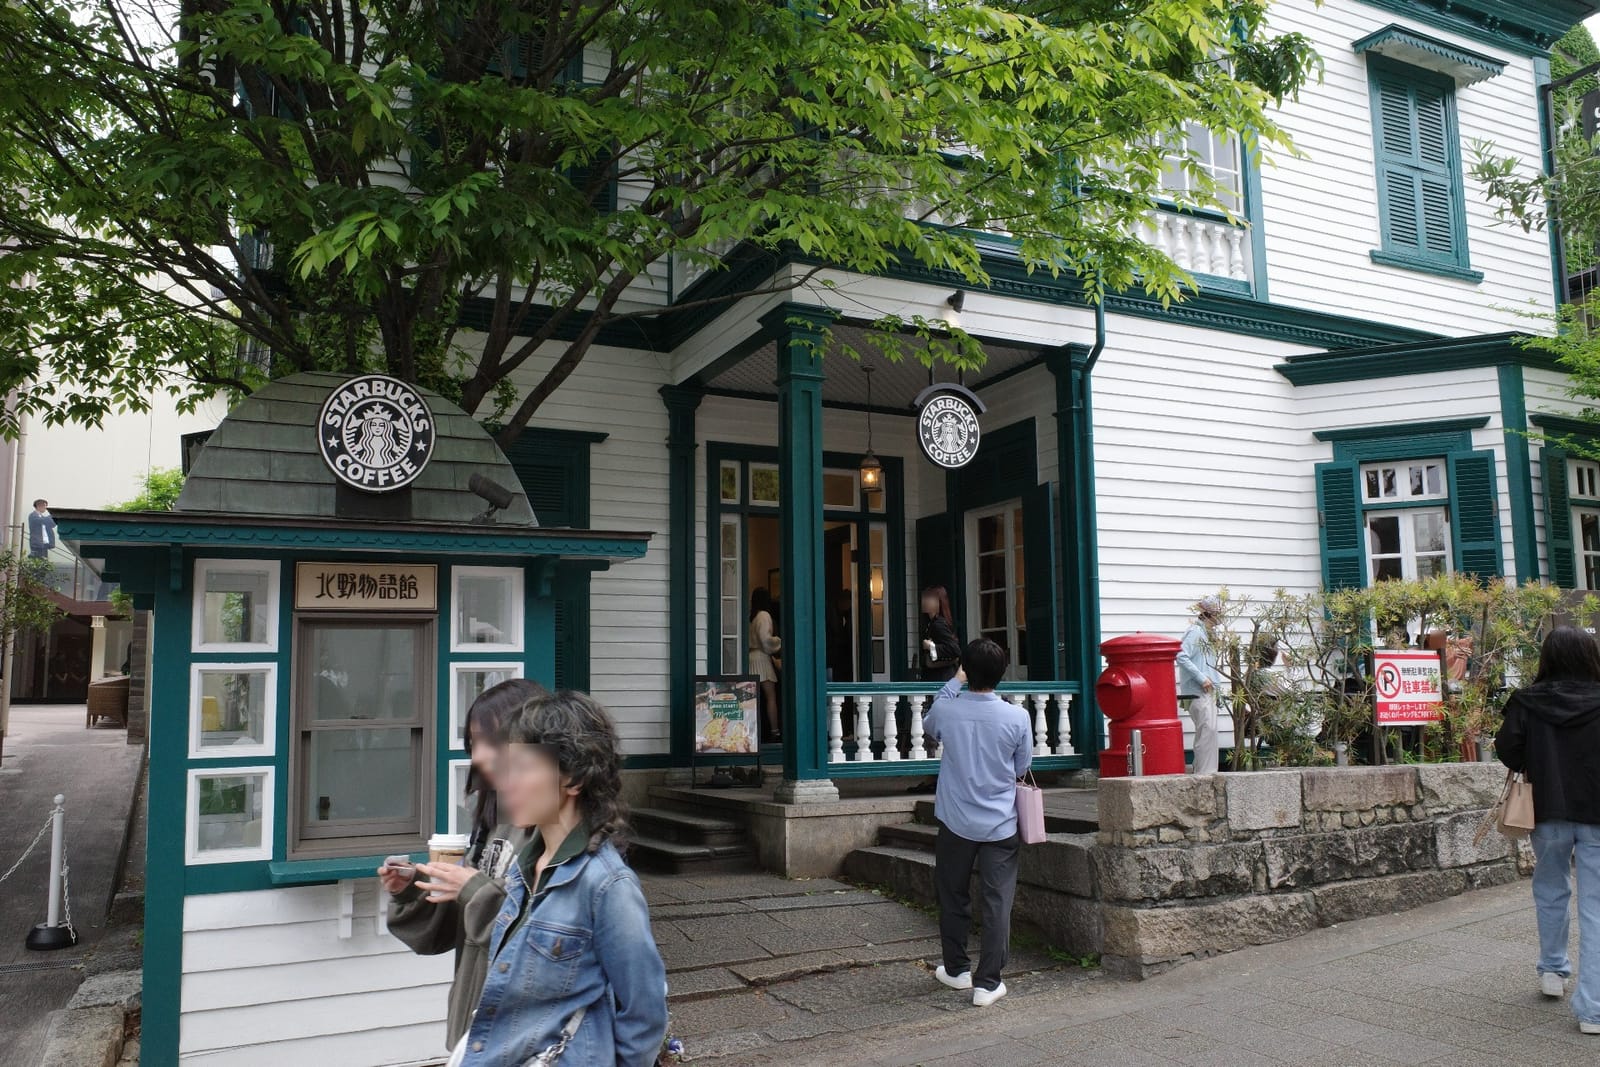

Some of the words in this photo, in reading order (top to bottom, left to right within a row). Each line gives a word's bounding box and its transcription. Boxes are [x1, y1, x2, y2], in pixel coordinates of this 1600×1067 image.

[325, 380, 430, 433] STARBUCKS
[922, 399, 977, 433] STARBUCKS
[928, 443, 971, 465] COFFEE
[335, 454, 417, 486] COFFEE
[315, 572, 418, 599] 北野物語館
[1402, 679, 1440, 694] 駐車禁止
